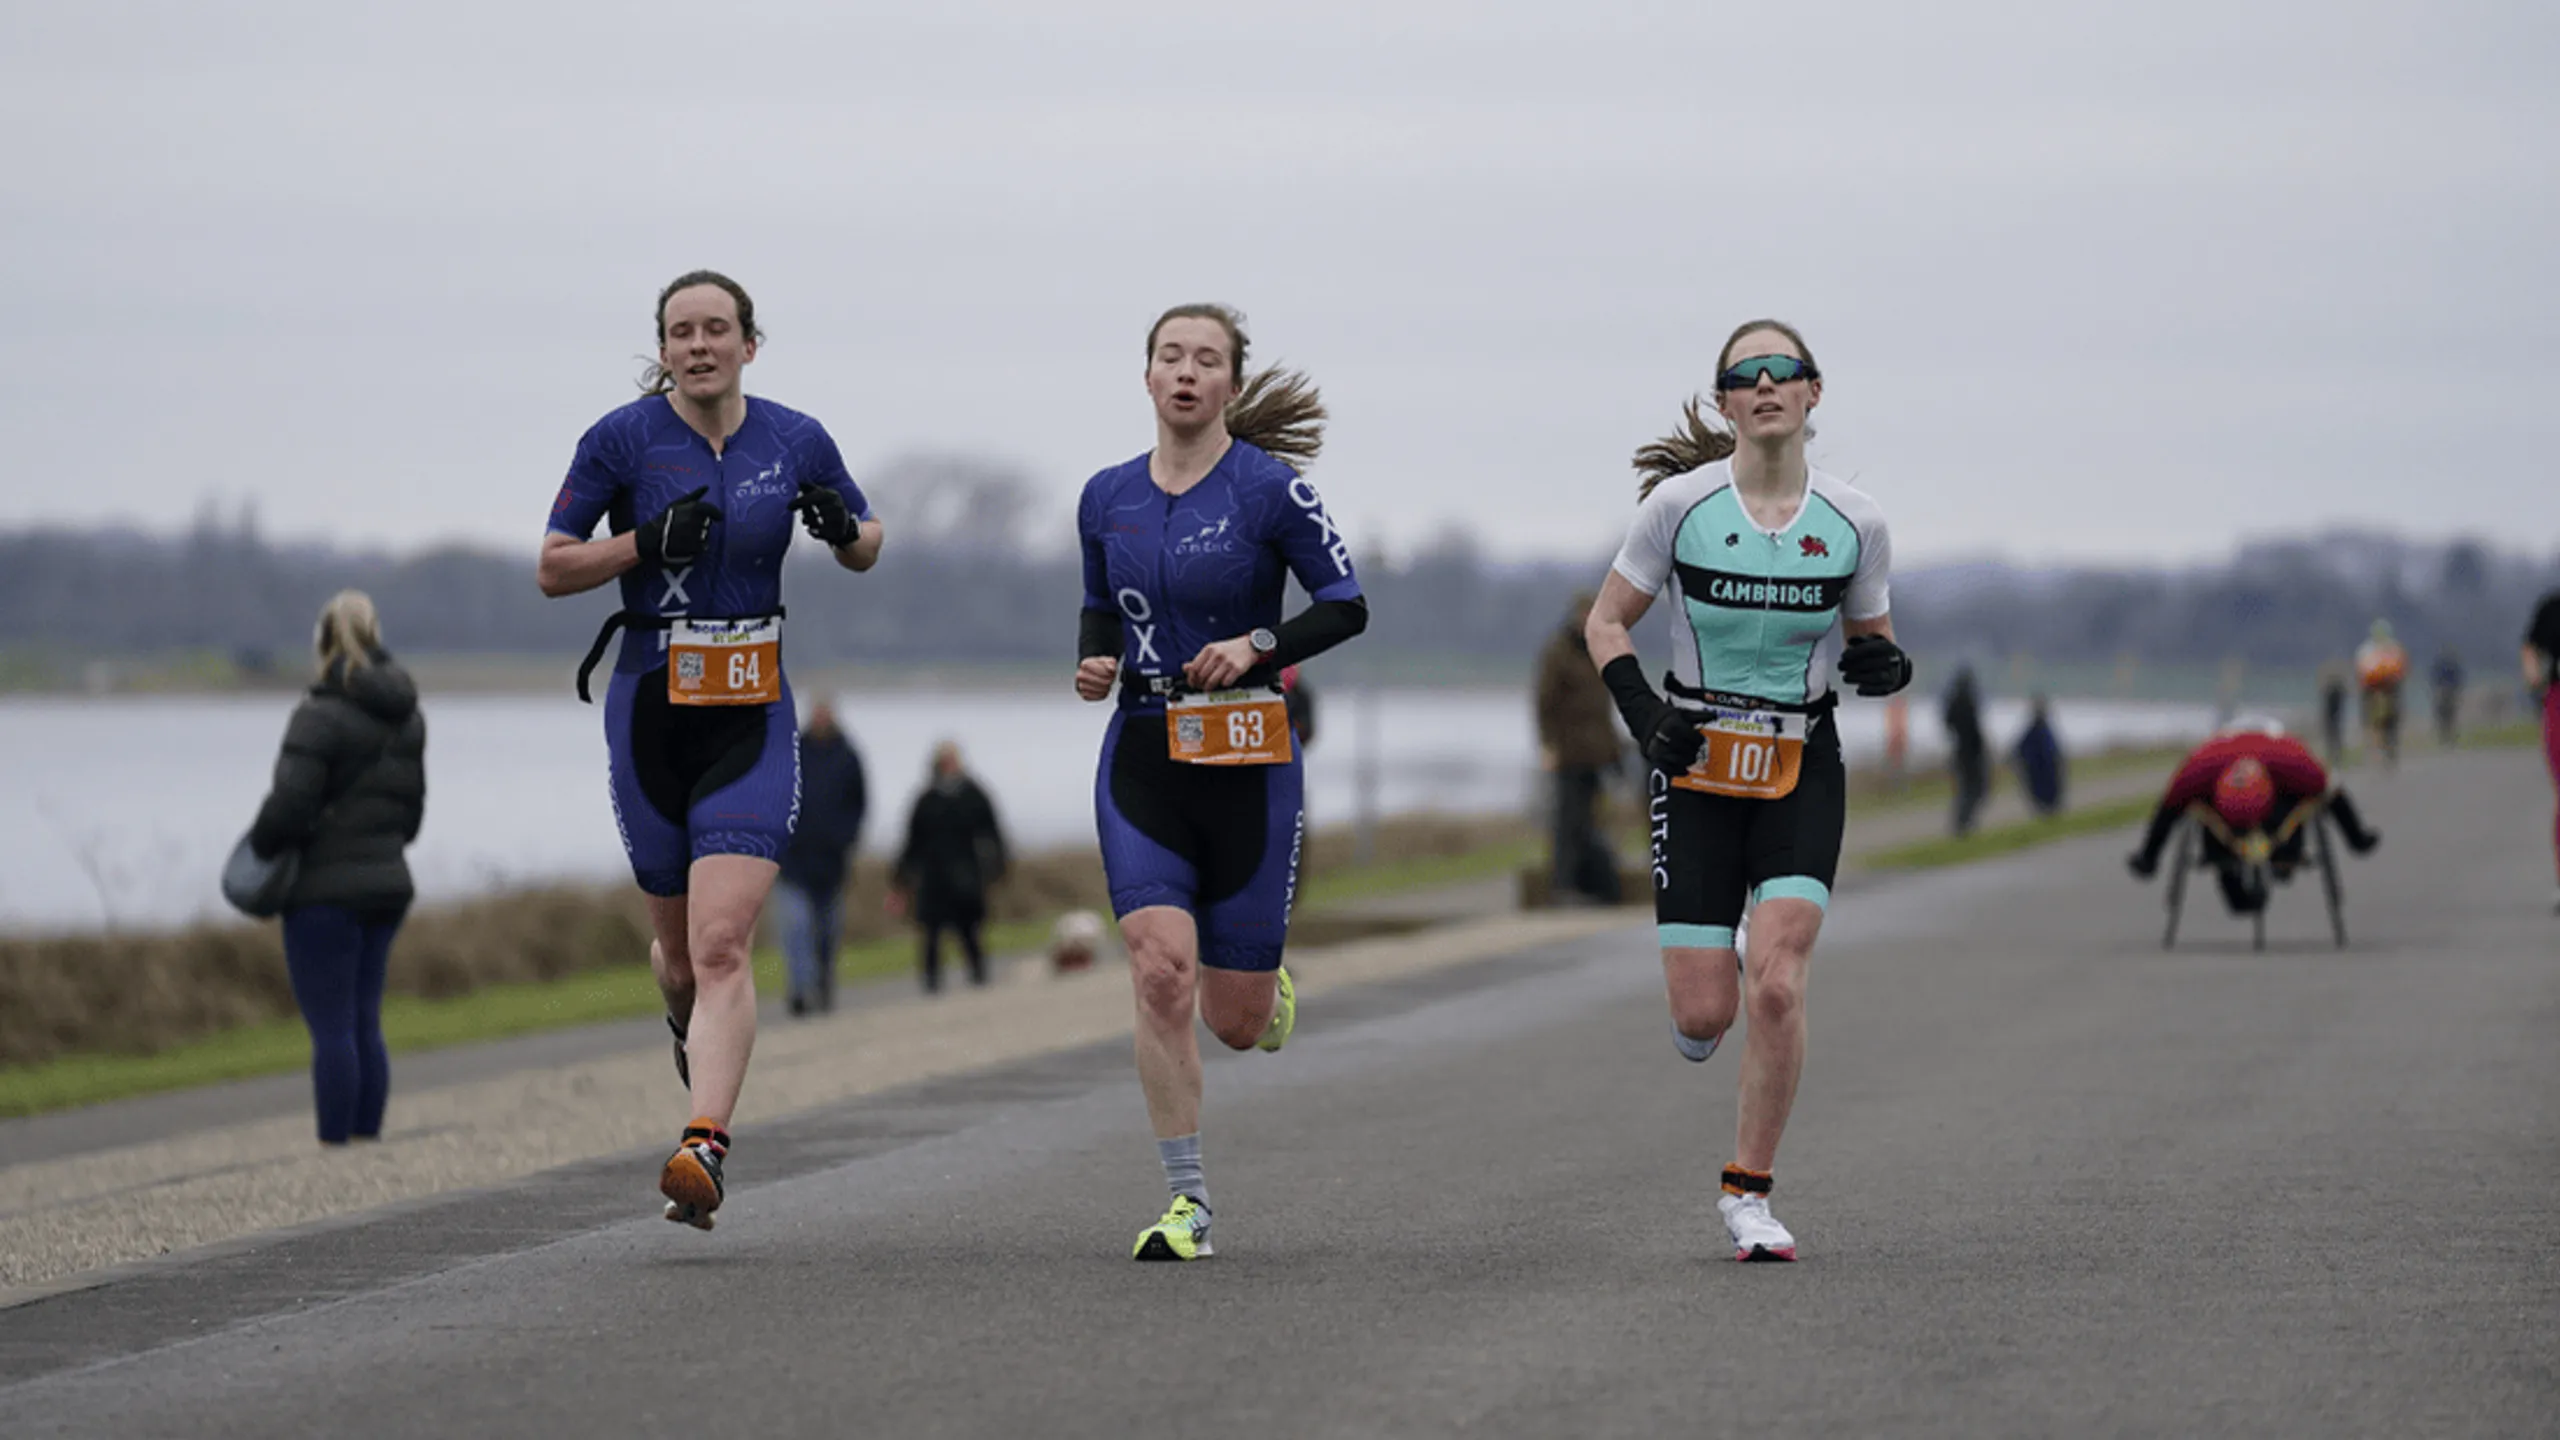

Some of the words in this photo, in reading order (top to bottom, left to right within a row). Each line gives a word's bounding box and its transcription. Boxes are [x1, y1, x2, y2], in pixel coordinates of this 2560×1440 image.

[1710, 578, 1823, 605] CAMBRIDGE
[727, 651, 761, 690] 64
[1227, 709, 1265, 749] 63
[1729, 741, 1775, 782] 101
